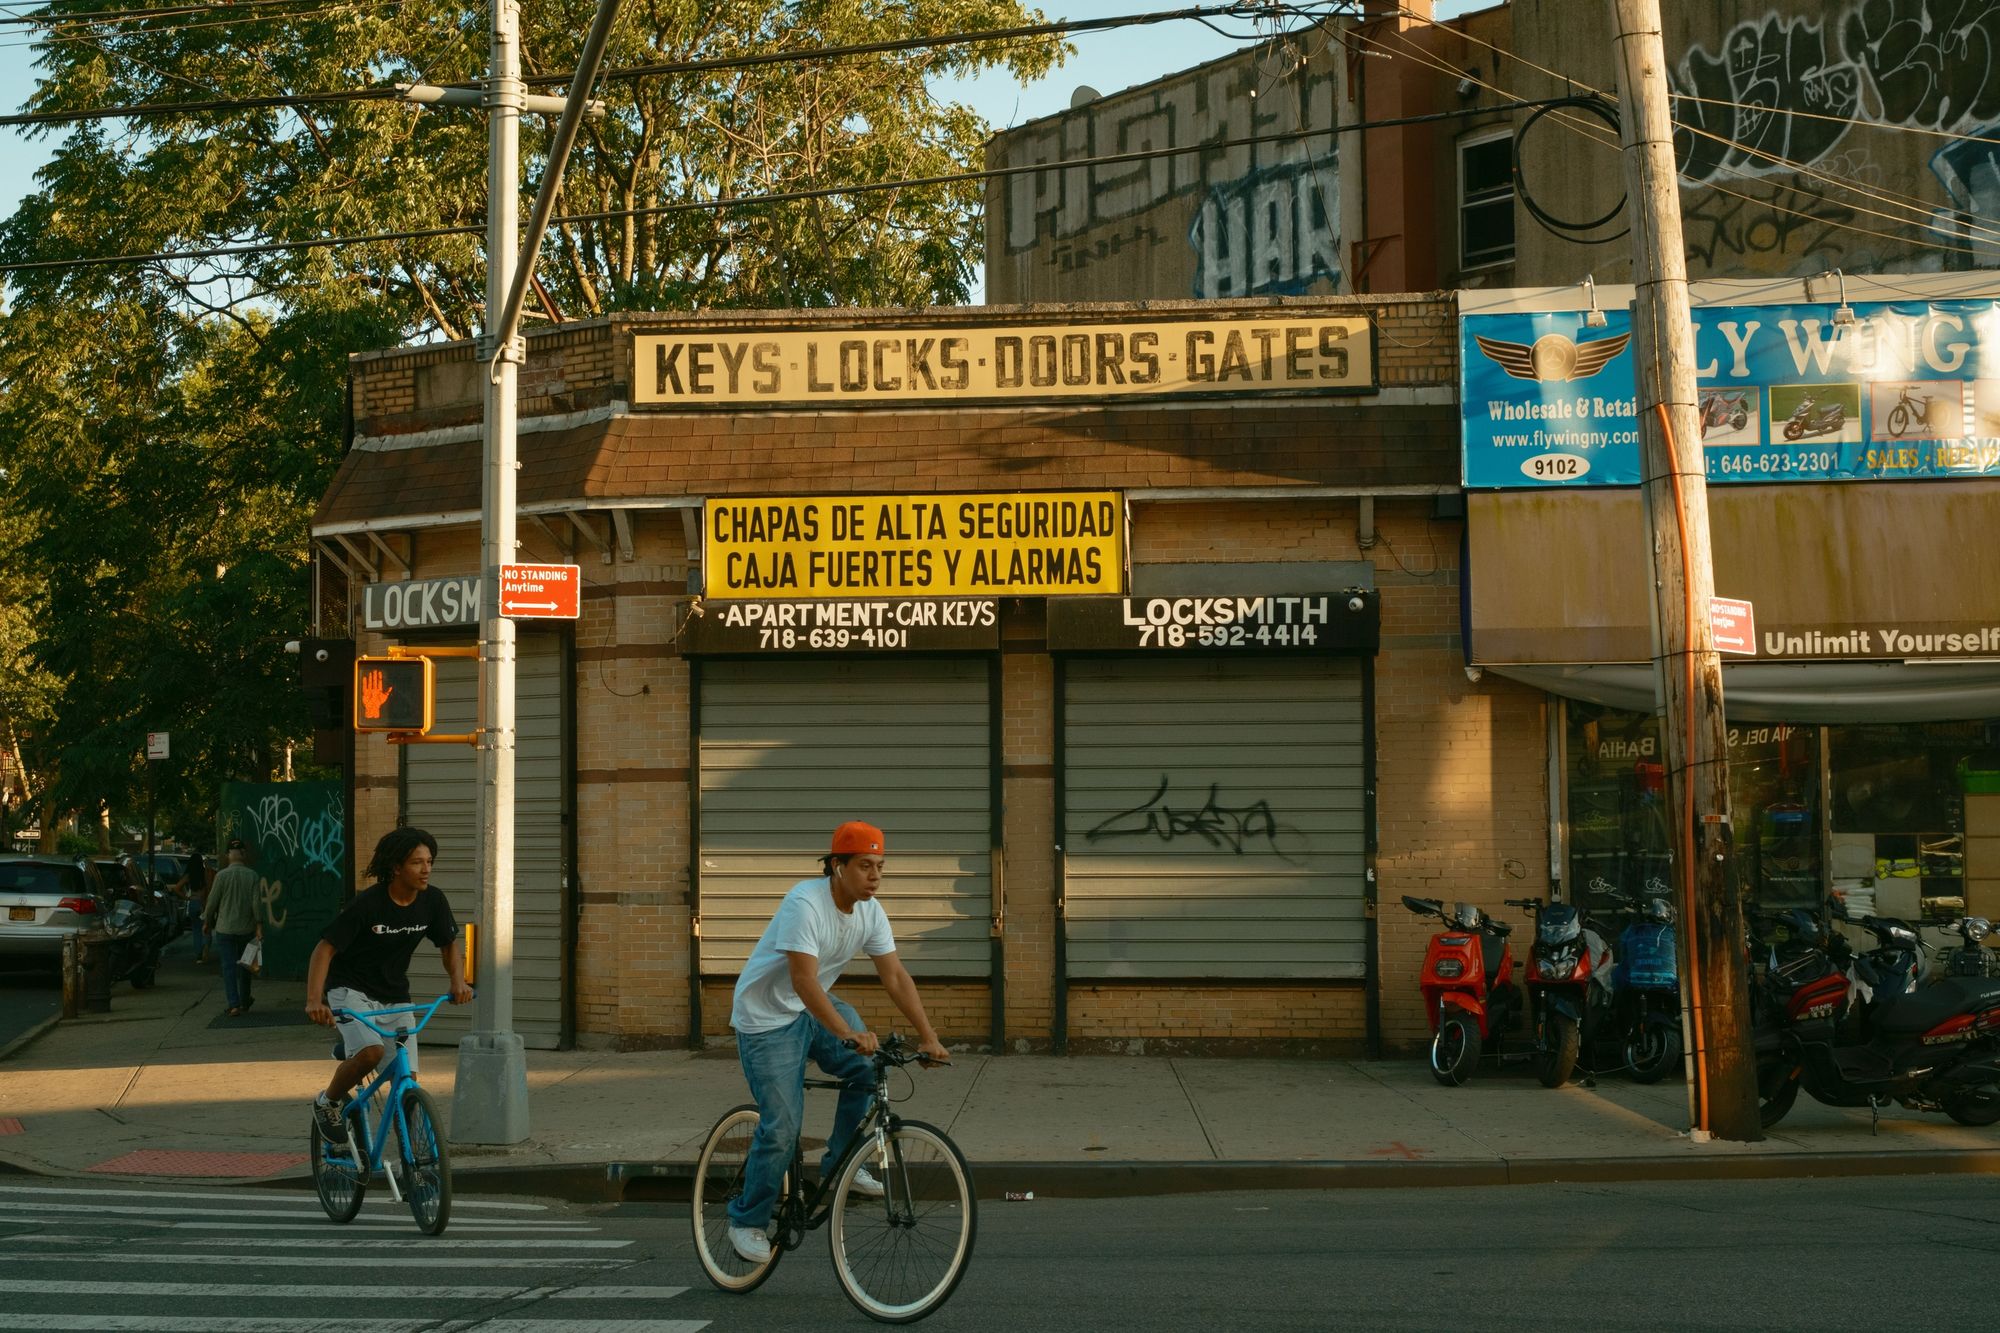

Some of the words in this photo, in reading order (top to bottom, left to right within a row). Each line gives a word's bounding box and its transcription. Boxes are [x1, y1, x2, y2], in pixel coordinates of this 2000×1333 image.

[1692, 321, 1761, 378] LY
[1778, 316, 1971, 376] WING
[656, 342, 781, 395] KEYS
[807, 337, 969, 393] LOCKS
[995, 331, 1160, 388] DOORS
[1186, 325, 1349, 383] GATES
[1488, 398, 1572, 421] Wholesale
[1575, 397, 1590, 418] &
[1593, 396, 1638, 418] Retai
[1535, 459, 1577, 475] 9102
[1721, 452, 1839, 474] 646-623-2301
[1867, 448, 1918, 469] SALES
[714, 504, 819, 543] CHAPAS
[832, 504, 865, 541] DE
[875, 503, 947, 541] ALTA
[959, 501, 1114, 539] SEGURIDAD
[504, 570, 519, 580] NO
[521, 570, 568, 581] STANDING
[727, 552, 798, 589] CAJA
[809, 549, 932, 588] FUERTES
[943, 549, 961, 586] Y
[970, 547, 1101, 585] ALARMAS
[505, 582, 544, 594] Anytime
[365, 579, 481, 628] LOCKSM
[725, 602, 889, 627] APARTMENT
[895, 601, 937, 627] CAR
[942, 601, 995, 626] KEYS
[1123, 597, 1328, 626] LOCKSMITH
[759, 628, 907, 648] 718-639-4101
[1138, 624, 1318, 647] 718-592-4414
[1765, 630, 1870, 655] Unlimit
[1879, 628, 2000, 653] Yourself
